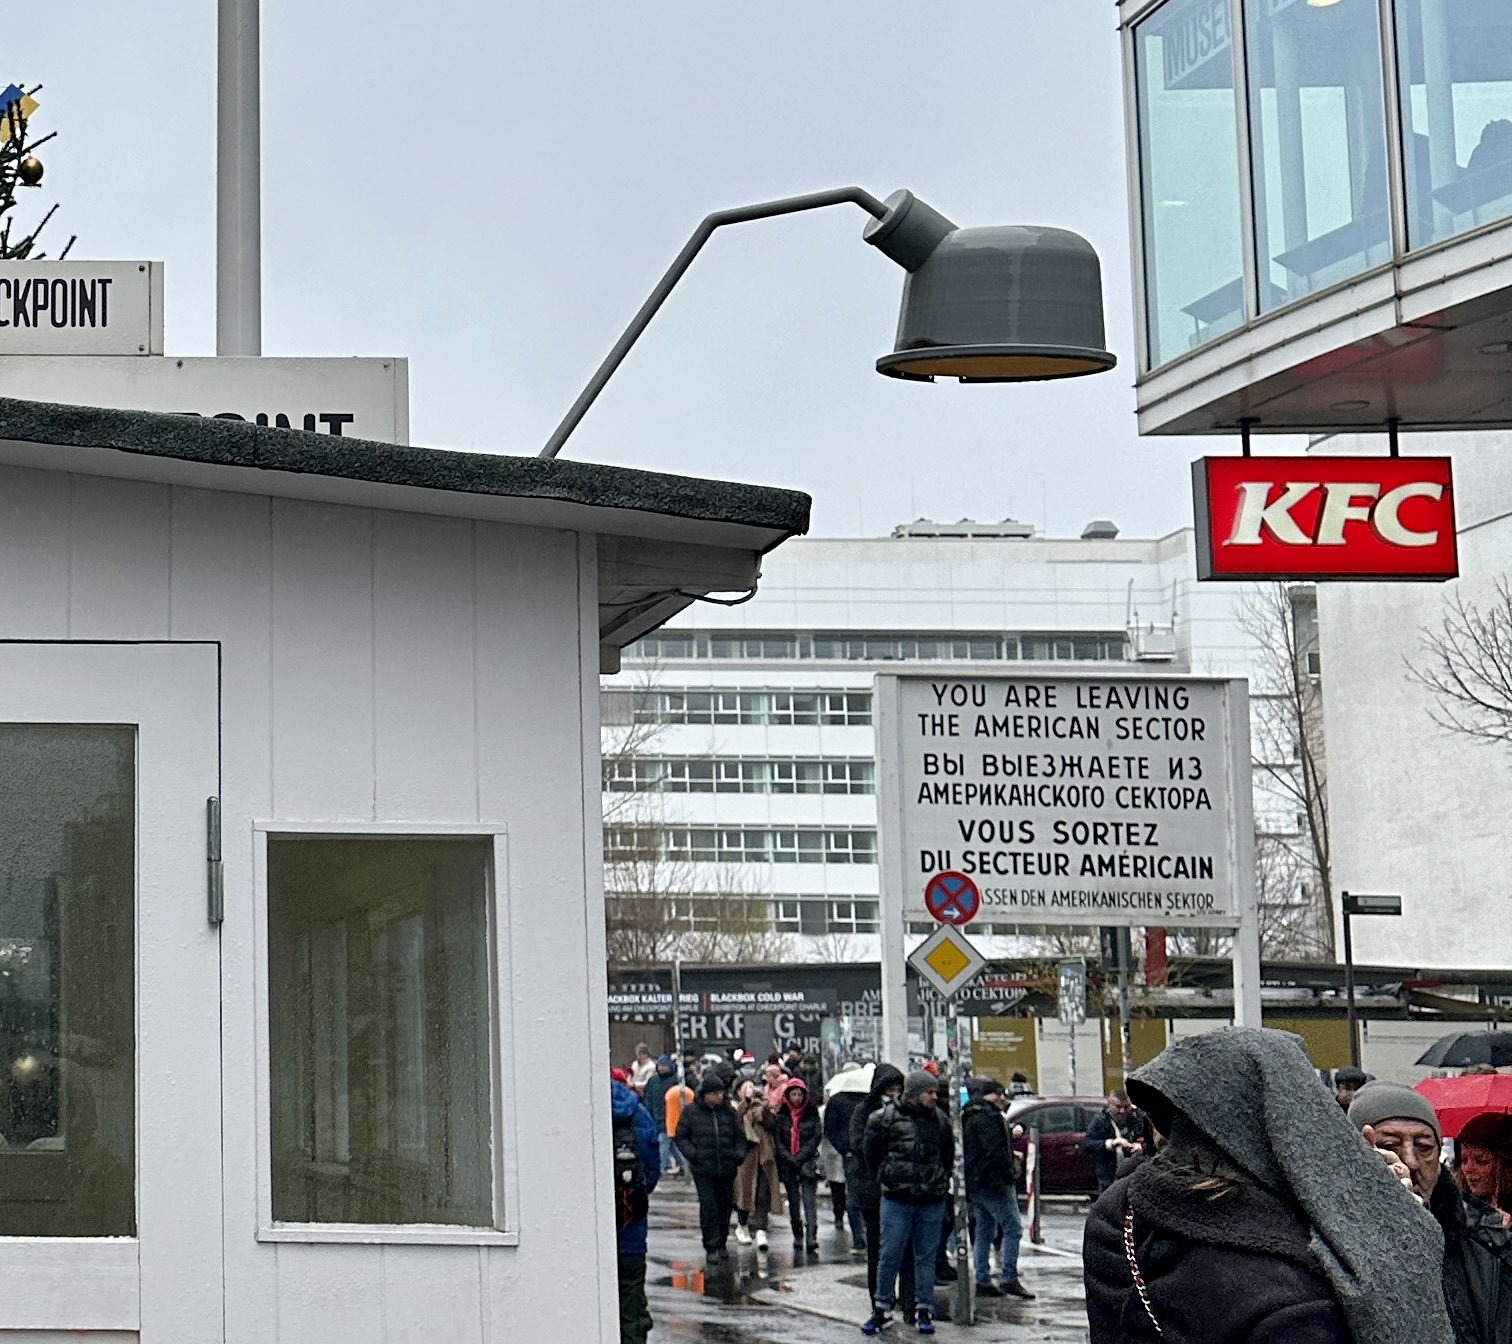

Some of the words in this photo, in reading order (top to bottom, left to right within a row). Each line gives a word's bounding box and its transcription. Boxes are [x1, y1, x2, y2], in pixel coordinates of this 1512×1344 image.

[1222, 481, 1444, 547] KFC
[931, 683, 986, 707] YOU
[1004, 685, 1058, 708] ARE
[1076, 685, 1190, 711] LEAVING
[917, 713, 960, 737] THE
[974, 714, 1100, 739] AMERICAN
[1115, 716, 1206, 741] SECTOR
[923, 752, 965, 776] ВЫ
[982, 754, 1150, 779] ВЫЕЗЖАЕТЕ
[1168, 756, 1203, 781] ИЗ
[917, 782, 1105, 807] АМЕРИКАНСКОГО
[1115, 785, 1213, 810] СЕКТОРА
[957, 819, 1036, 843] VOUS
[1052, 820, 1159, 846] SORTEZ
[920, 849, 952, 873] DU
[961, 850, 1070, 876] SECTEUR
[1021, 888, 1047, 908] DEN
[1050, 888, 1163, 910] AMERIKANISCHEN
[1166, 891, 1216, 911] SEKTOR
[710, 992, 756, 1003] BLACKBOX
[757, 992, 782, 1003] COLD
[782, 992, 805, 1002] WAR
